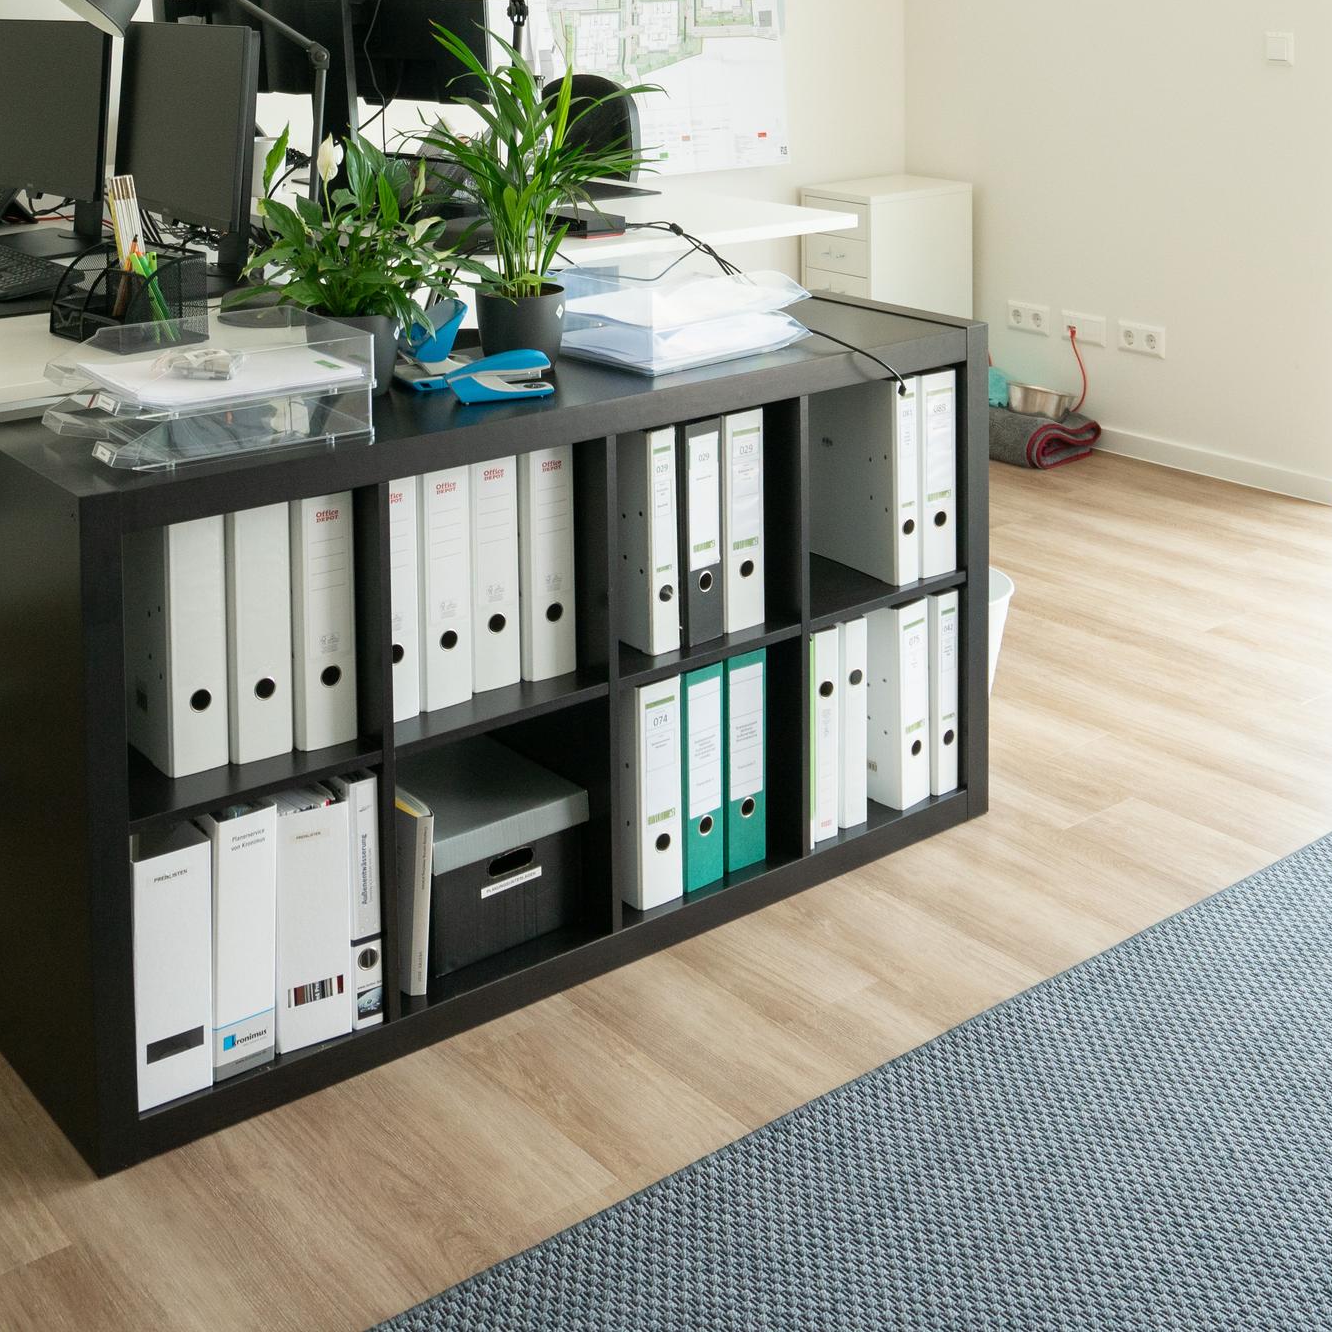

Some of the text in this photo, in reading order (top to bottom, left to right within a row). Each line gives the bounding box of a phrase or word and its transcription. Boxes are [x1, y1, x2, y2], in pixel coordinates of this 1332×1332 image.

[739, 444, 754, 455] 029
[698, 452, 710, 462] 029
[541, 459, 562, 469] Office
[656, 464, 669, 474] 029
[483, 468, 505, 478] Office
[435, 481, 457, 491] Office
[390, 492, 403, 500] fice
[315, 508, 339, 518] Office
[316, 515, 339, 523] DEPOT
[653, 714, 668, 728] 074
[230, 836, 266, 852] von Kronimus
